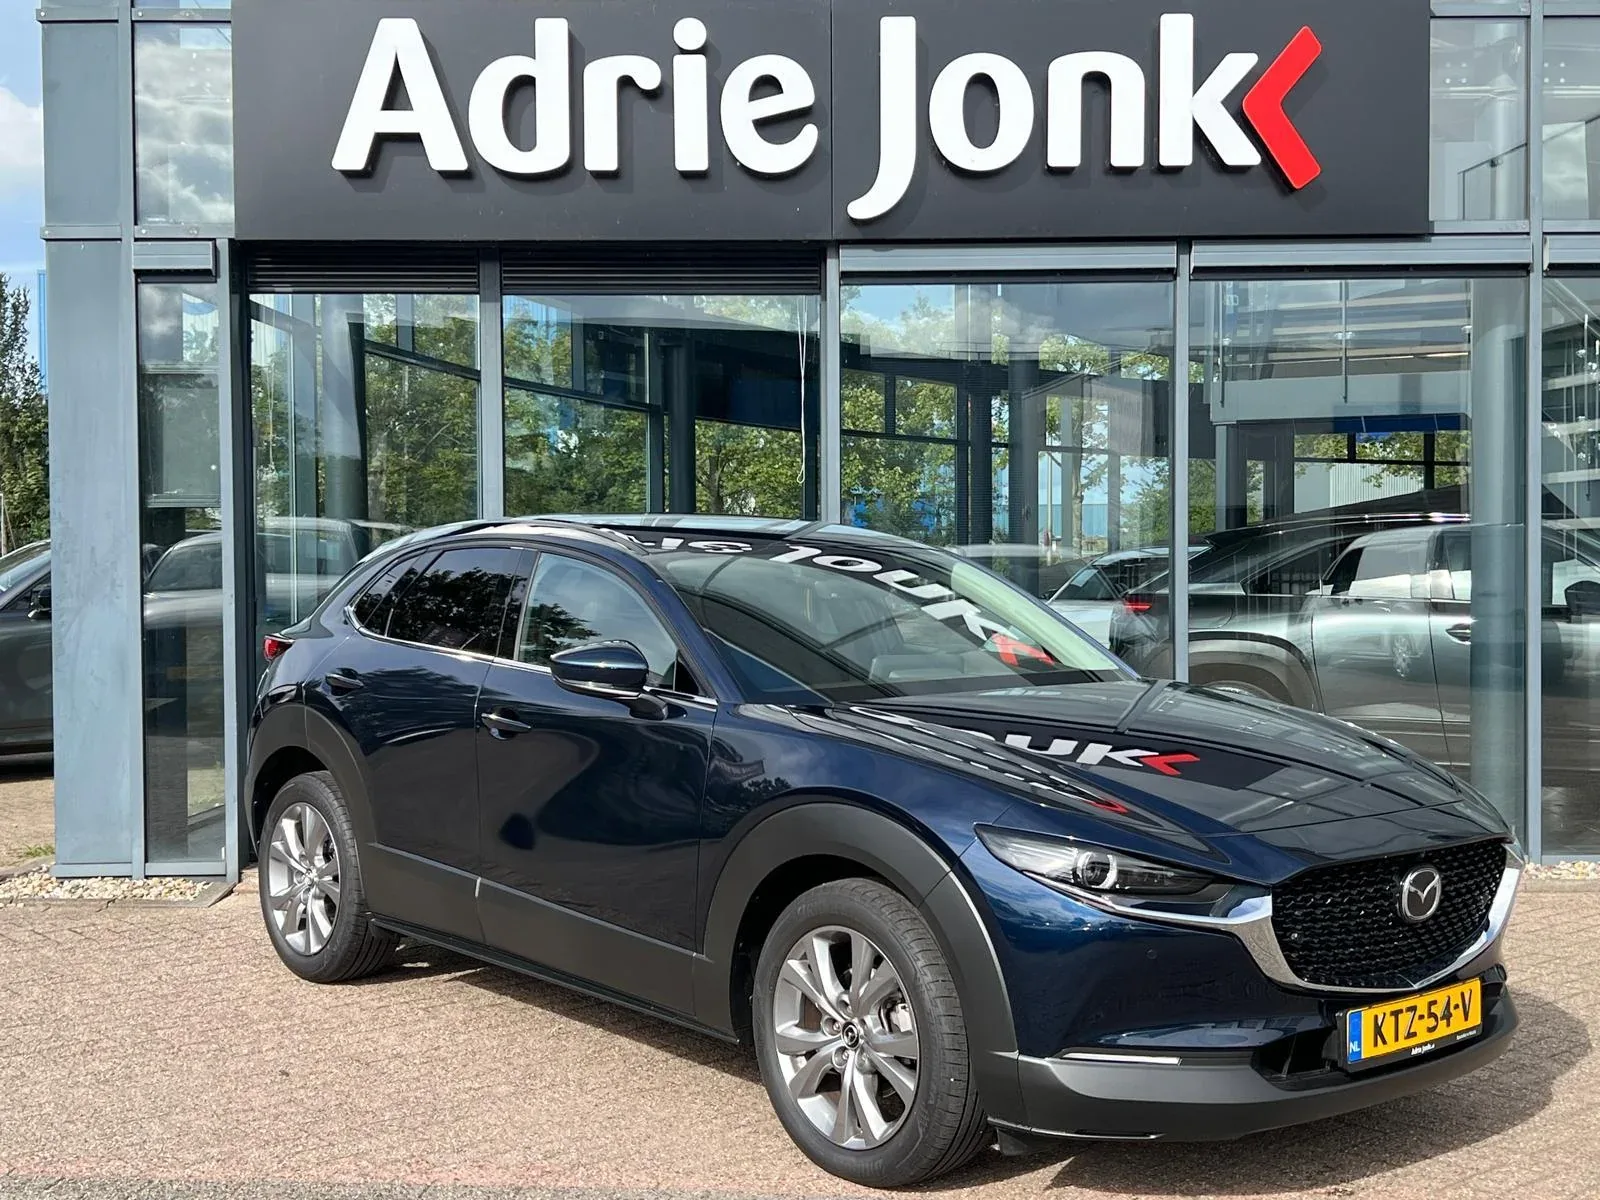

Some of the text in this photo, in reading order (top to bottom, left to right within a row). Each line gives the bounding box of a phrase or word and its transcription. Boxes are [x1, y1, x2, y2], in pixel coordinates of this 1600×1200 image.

[332, 14, 1261, 218] Adrie Jonk
[1349, 1041, 1361, 1054] NL
[1373, 988, 1473, 1048] KTZ-54-V
